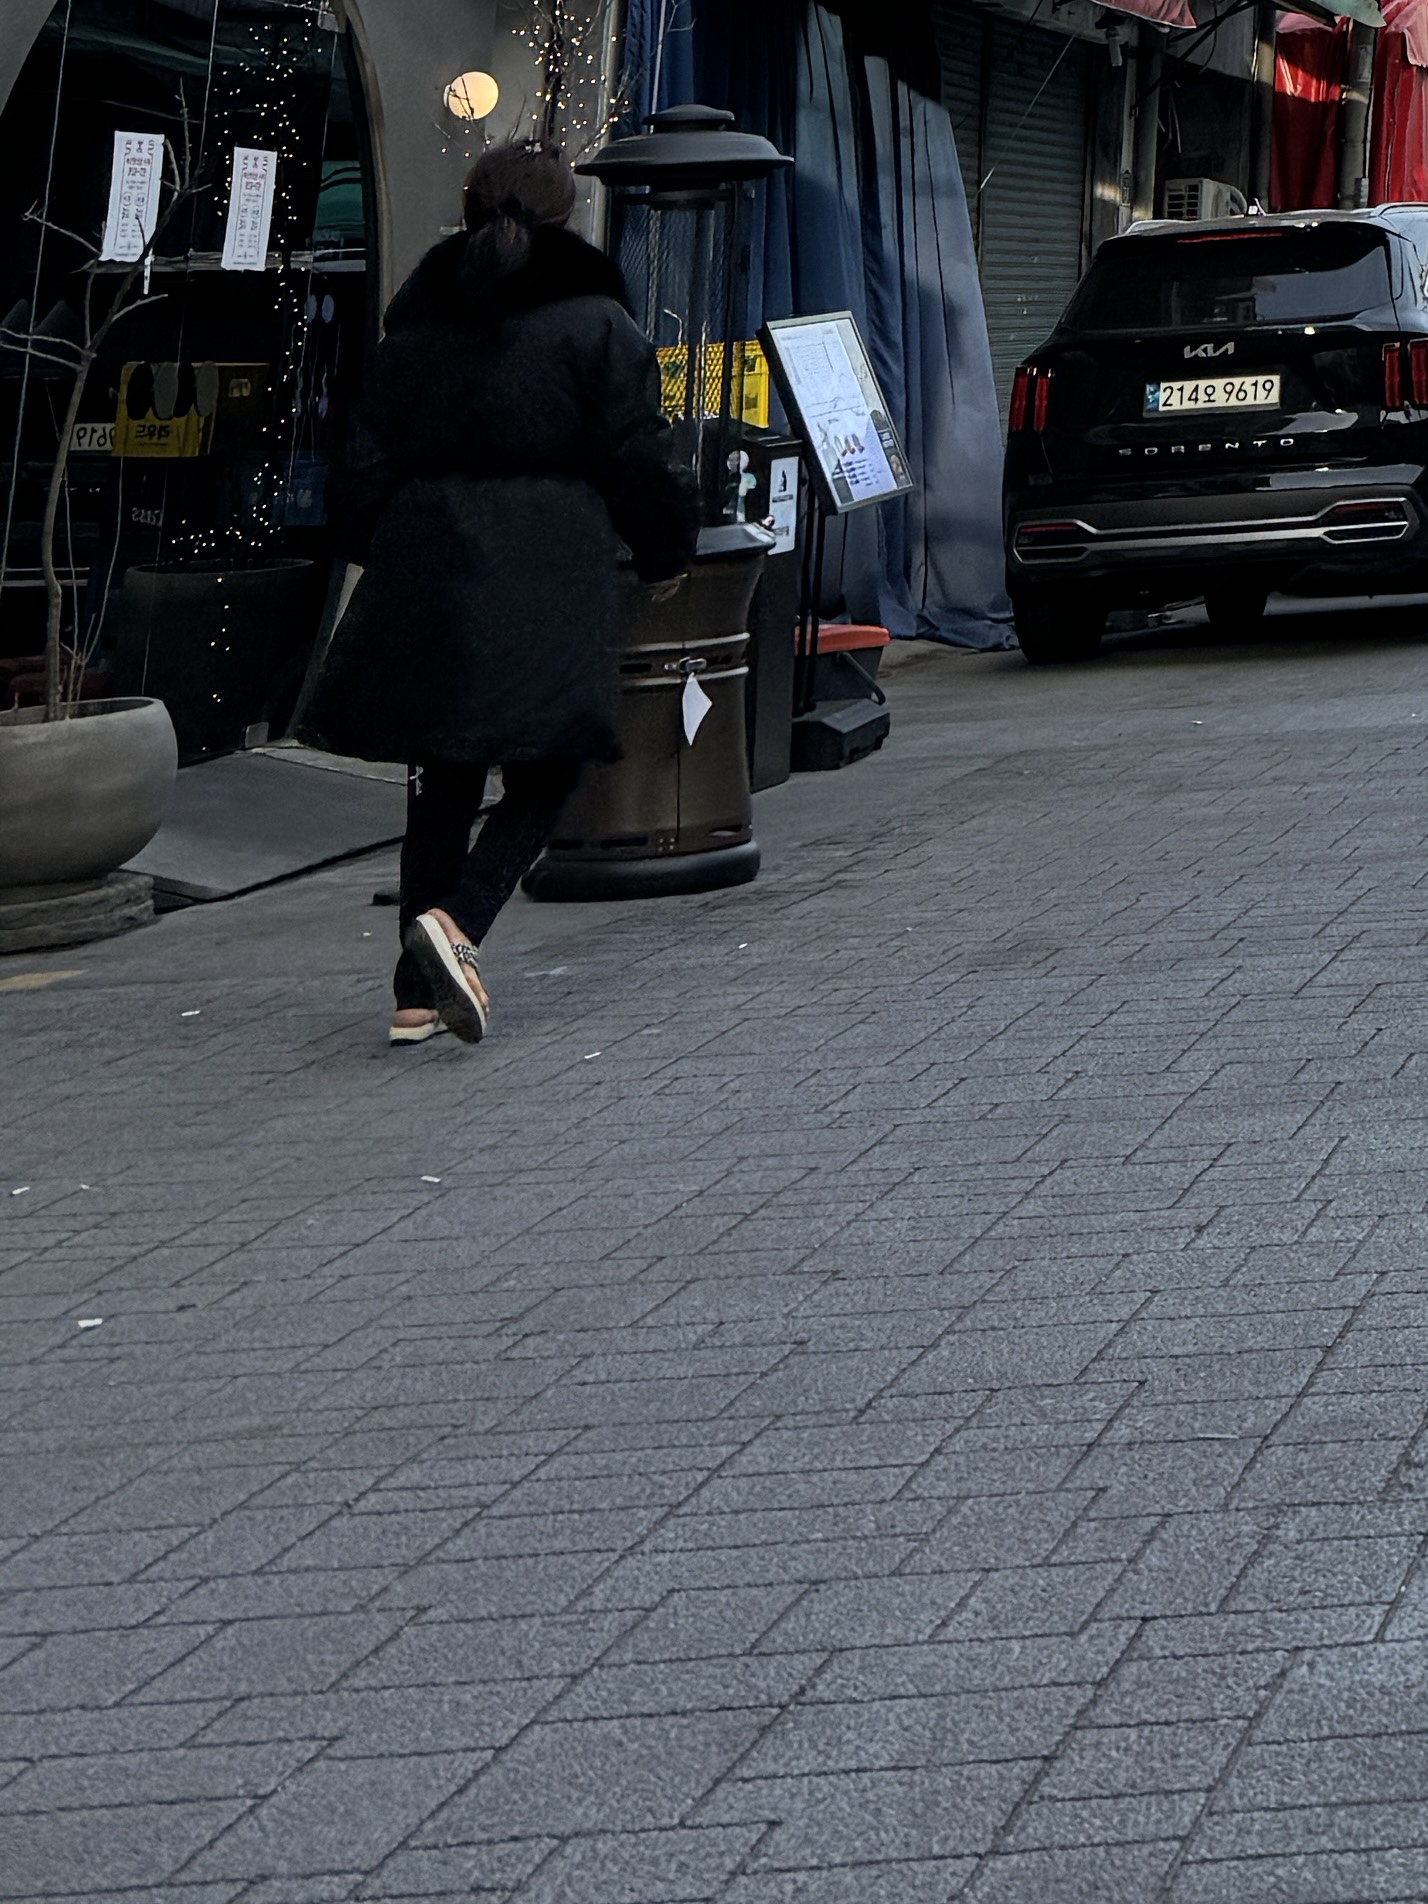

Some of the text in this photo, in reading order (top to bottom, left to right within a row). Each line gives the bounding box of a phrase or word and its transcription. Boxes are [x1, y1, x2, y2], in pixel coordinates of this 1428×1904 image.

[1184, 342, 1235, 359] KIA
[1161, 379, 1275, 408] 214오 9619
[1118, 438, 1294, 456] SORENTO
